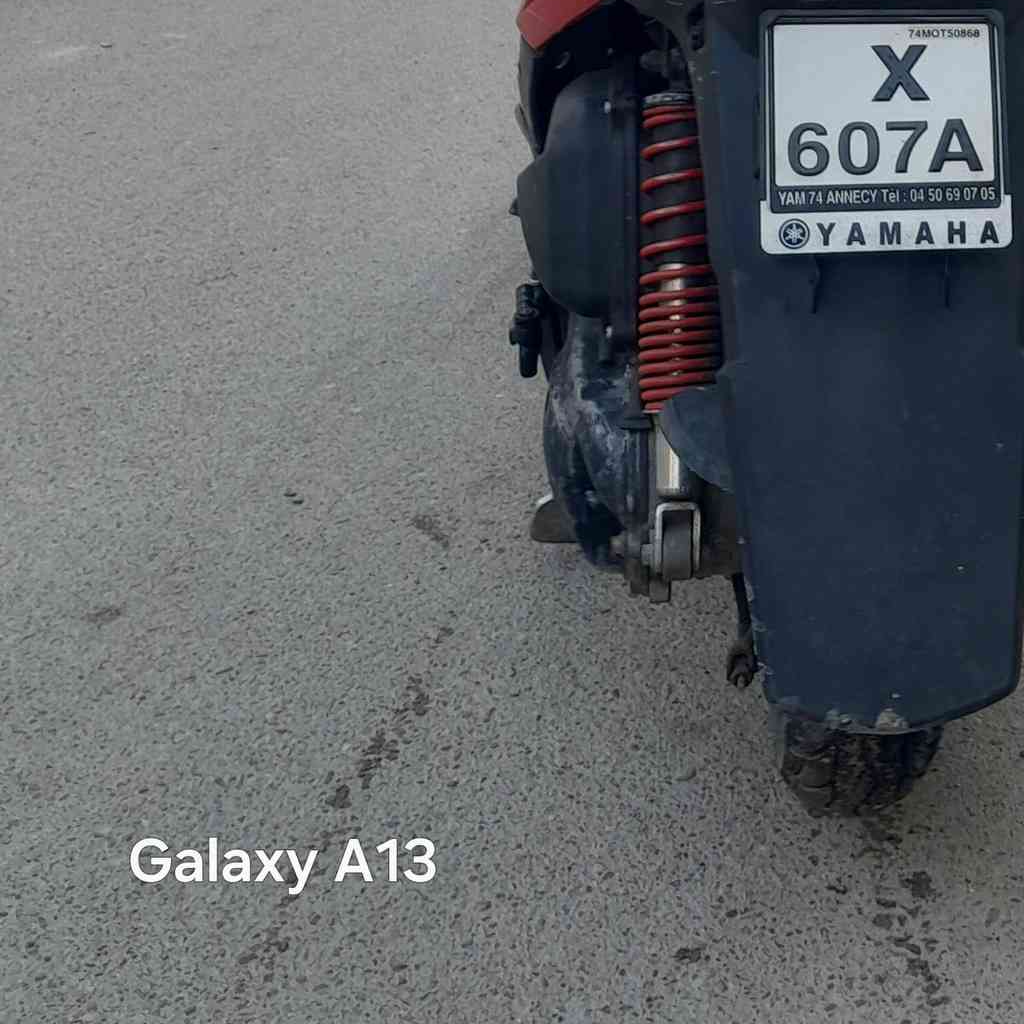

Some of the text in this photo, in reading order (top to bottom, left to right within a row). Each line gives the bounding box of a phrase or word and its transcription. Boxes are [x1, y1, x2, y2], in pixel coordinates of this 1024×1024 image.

[871, 44, 930, 102] X
[787, 118, 984, 176] 607A
[778, 191, 806, 206] YAM
[808, 191, 823, 204] 74
[826, 189, 877, 204] ANNECY
[910, 188, 925, 202] 04
[928, 187, 943, 201] 50
[945, 187, 961, 201] 69
[963, 187, 978, 201] 07
[980, 186, 996, 200] 05
[816, 221, 999, 246] YAMAHA
